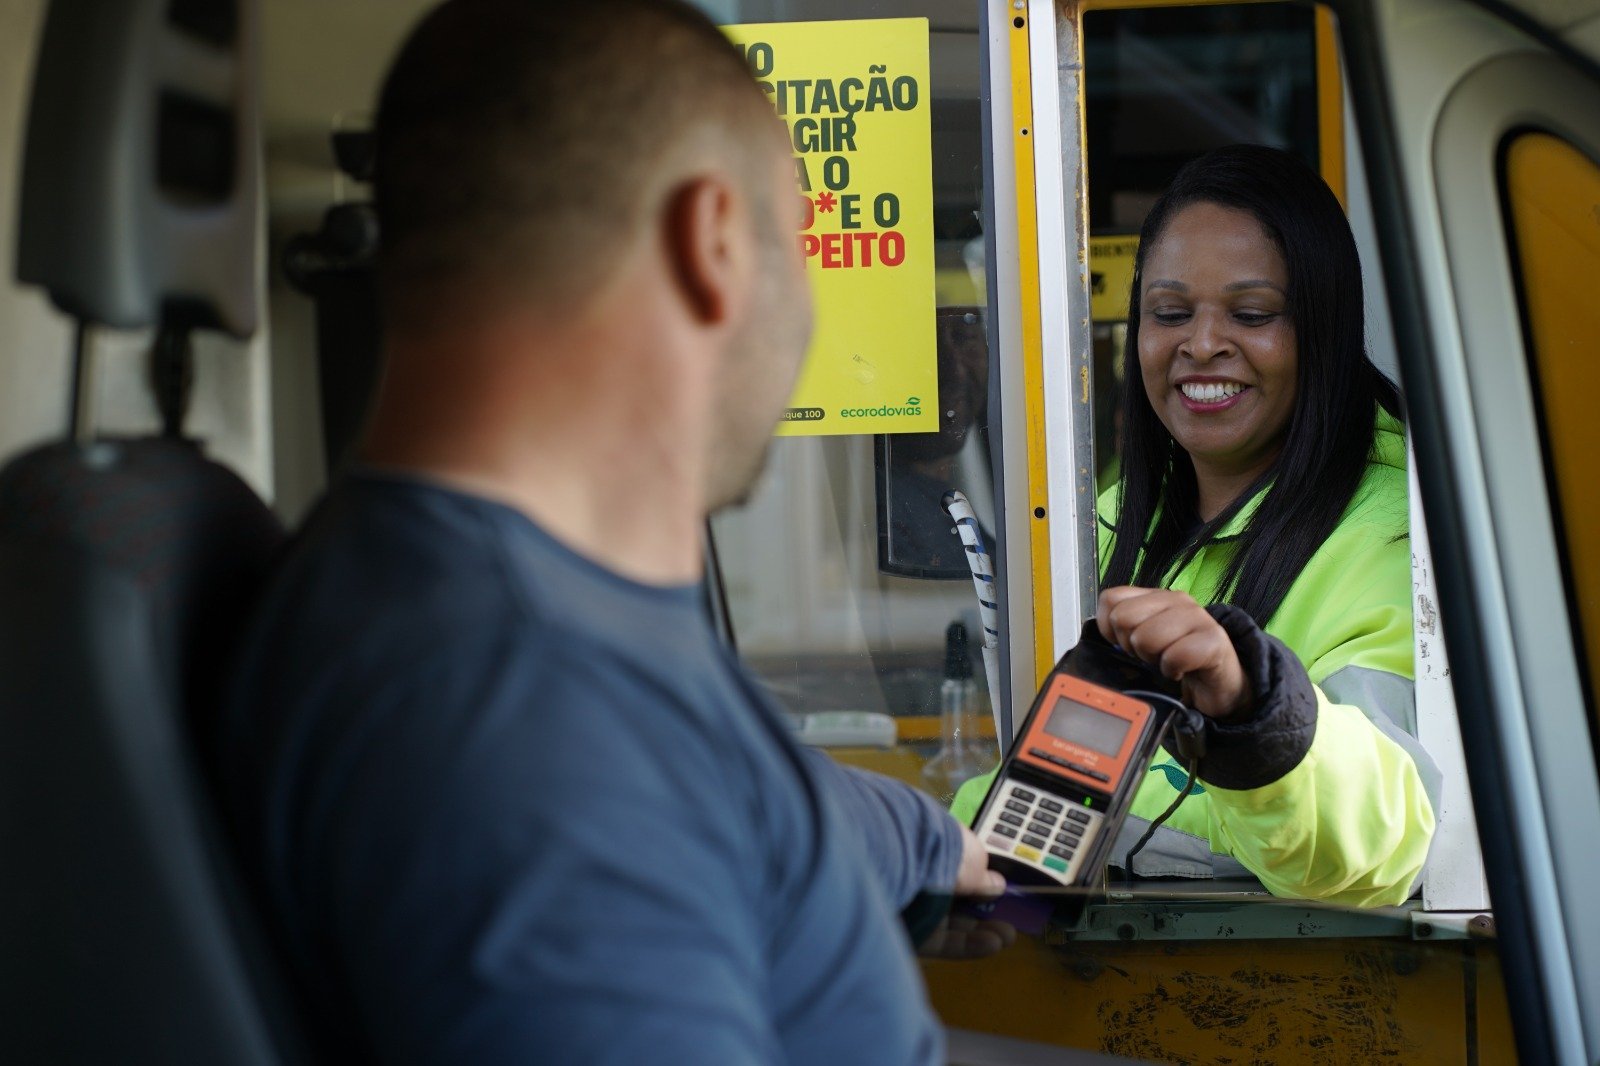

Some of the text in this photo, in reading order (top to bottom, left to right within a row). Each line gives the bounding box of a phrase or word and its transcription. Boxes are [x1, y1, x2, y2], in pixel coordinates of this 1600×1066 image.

[735, 43, 774, 77] O
[823, 155, 850, 191] O
[841, 194, 862, 229] E
[873, 192, 900, 228] O
[804, 410, 821, 418] 100
[840, 404, 921, 418] ecorodovias
